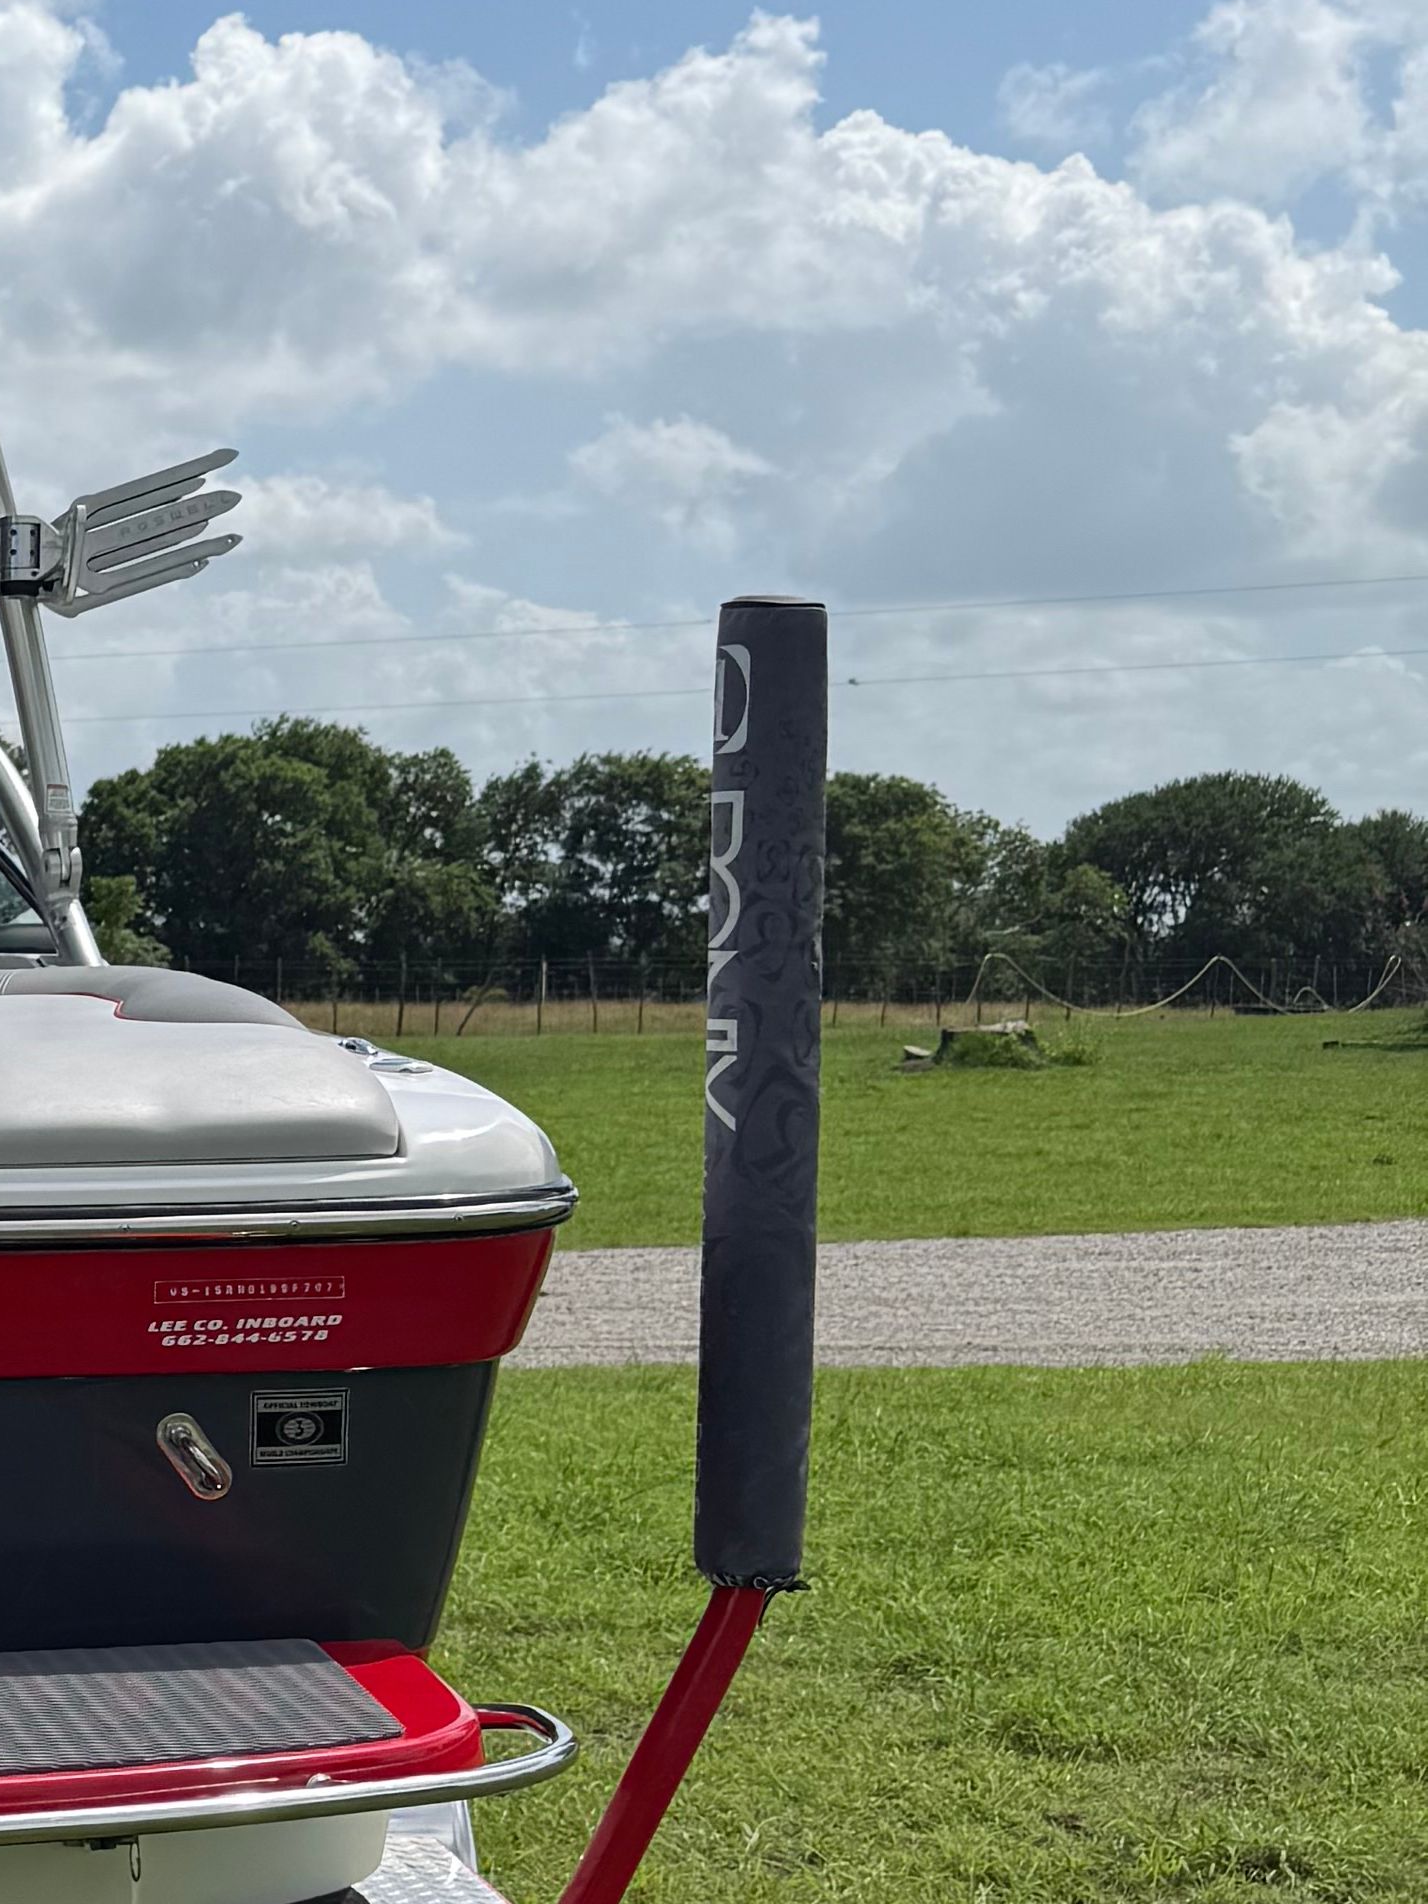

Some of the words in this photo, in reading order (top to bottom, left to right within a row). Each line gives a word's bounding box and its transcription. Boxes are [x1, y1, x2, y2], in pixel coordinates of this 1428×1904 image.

[147, 1319, 188, 1333] LEE
[193, 1318, 229, 1331] CO.
[235, 1314, 343, 1329] INBOARD
[161, 1330, 329, 1347] 662-844-6578
